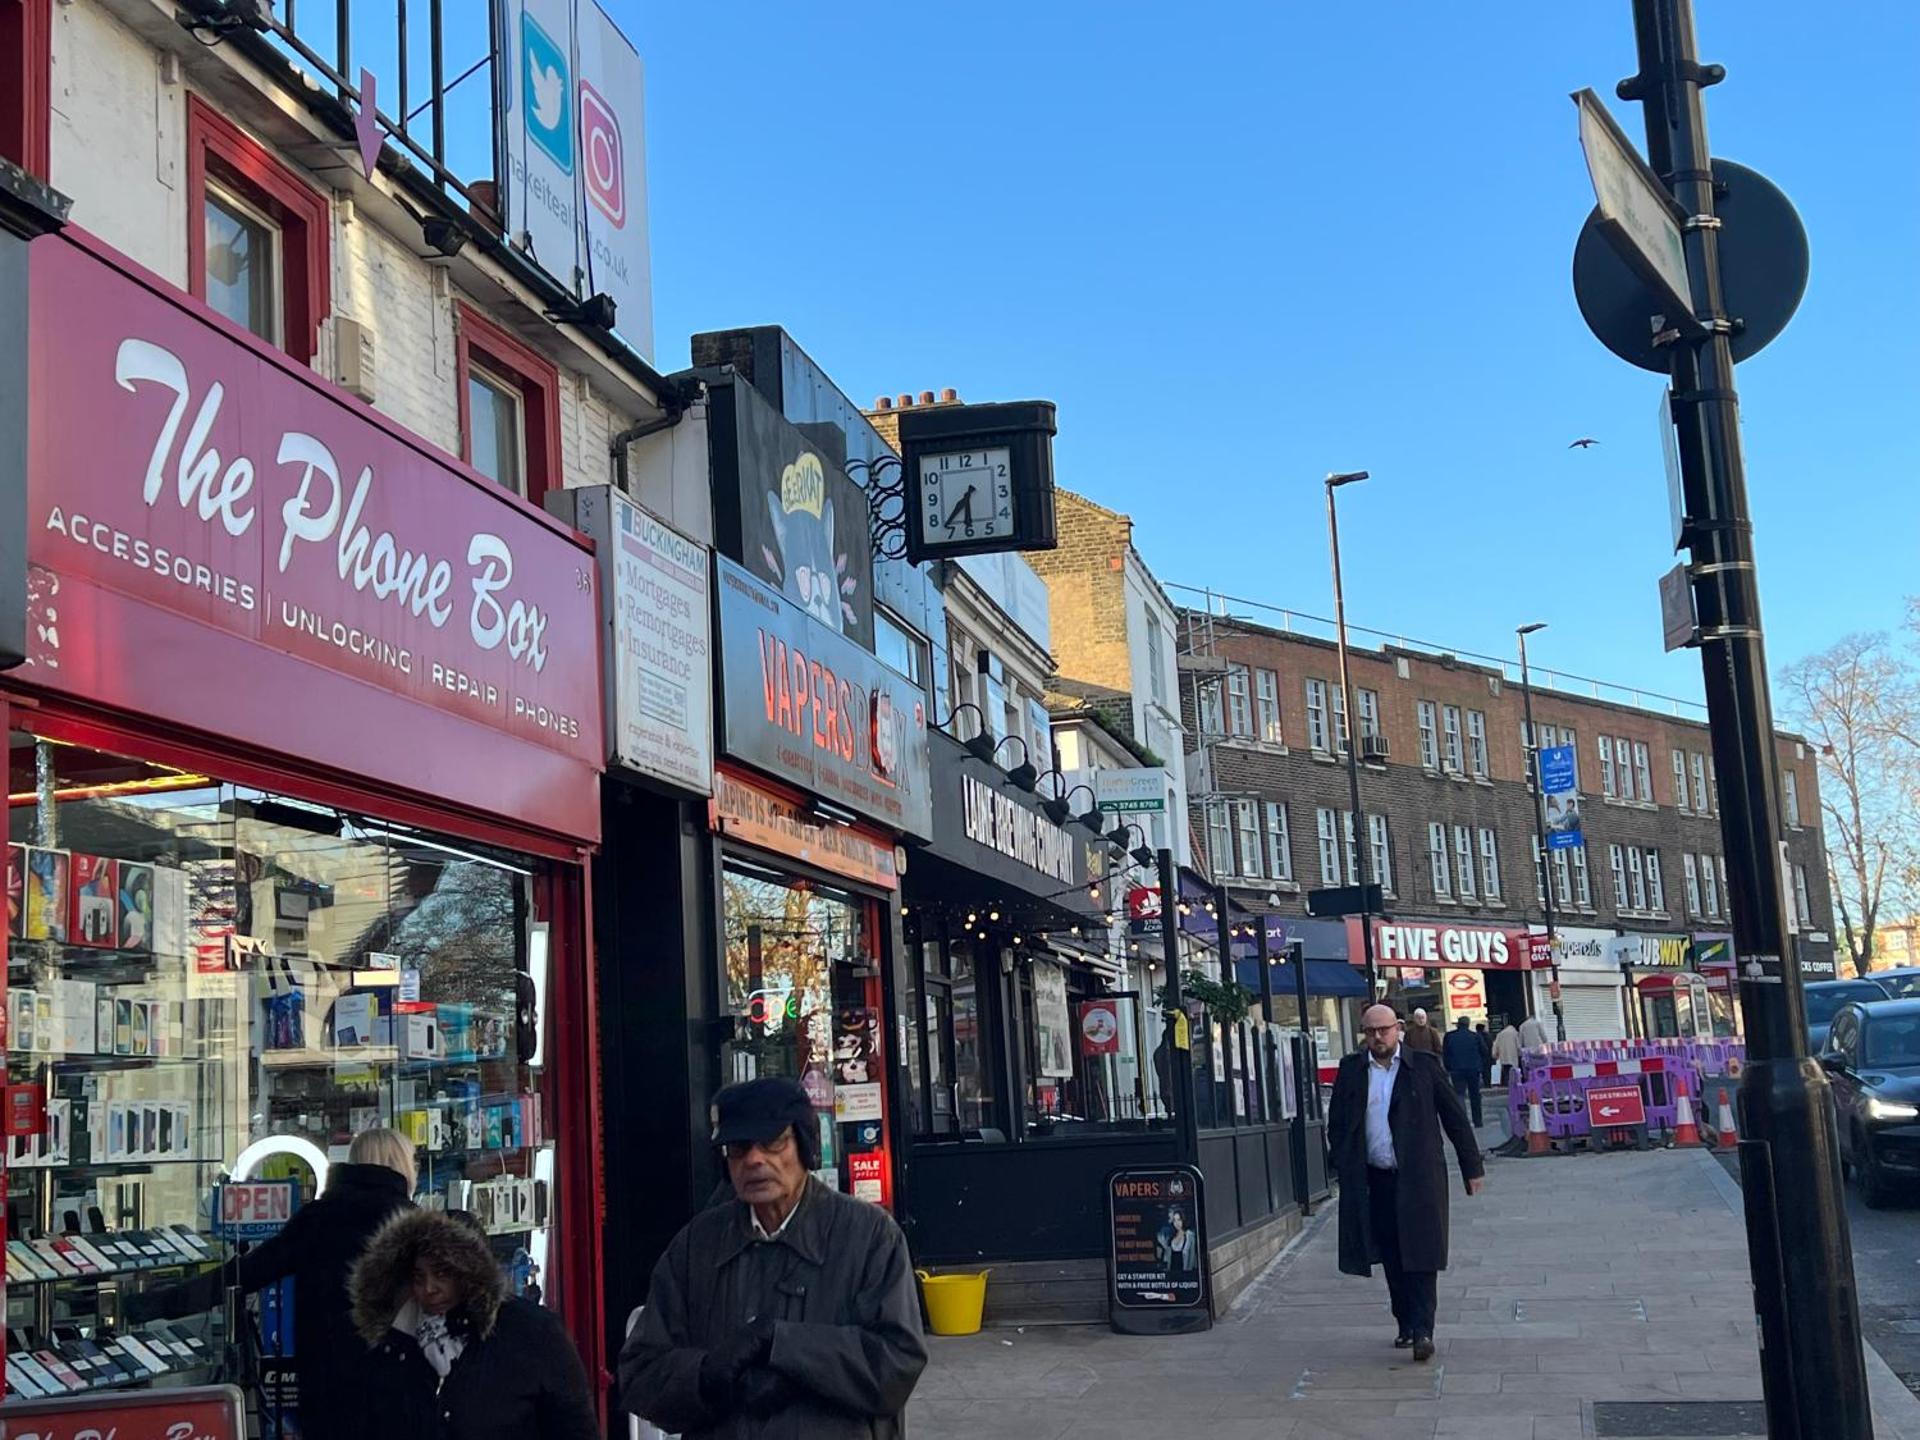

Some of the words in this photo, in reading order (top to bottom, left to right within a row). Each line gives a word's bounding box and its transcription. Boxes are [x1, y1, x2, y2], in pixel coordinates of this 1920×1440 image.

[940, 456, 949, 470] 11
[960, 454, 972, 468] 12
[983, 452, 988, 465] 1
[997, 464, 1007, 477] 2
[924, 472, 939, 485] 10
[998, 485, 1009, 498] 3
[115, 338, 255, 537] The
[276, 432, 453, 628] Phone
[467, 533, 548, 672] Box
[928, 493, 938, 506] 9
[998, 507, 1011, 519] 4
[929, 514, 939, 527] 8
[946, 525, 956, 539] 7
[965, 523, 975, 537] 6
[984, 522, 994, 535] 5
[631, 511, 706, 574] BUCKINGHAM
[625, 560, 691, 621] Mortgages
[47, 506, 255, 610] ACCESSORIES
[282, 601, 412, 673] UNLOCKING
[432, 663, 498, 704] REPAIR
[515, 697, 579, 738] PHONES
[626, 594, 706, 656] Remortgages
[627, 627, 692, 682] Insurance
[1266, 928, 1282, 938] art
[1380, 926, 1439, 961] FIVE
[1441, 928, 1509, 964] GUYS
[1560, 939, 1602, 960] upercuts
[1813, 961, 1834, 973] COFFEE
[1590, 1091, 1639, 1100] PEDESTRIANS
[853, 1160, 880, 1171] SALE
[1115, 1182, 1160, 1197] VAPERS
[224, 1186, 288, 1221] OPEN
